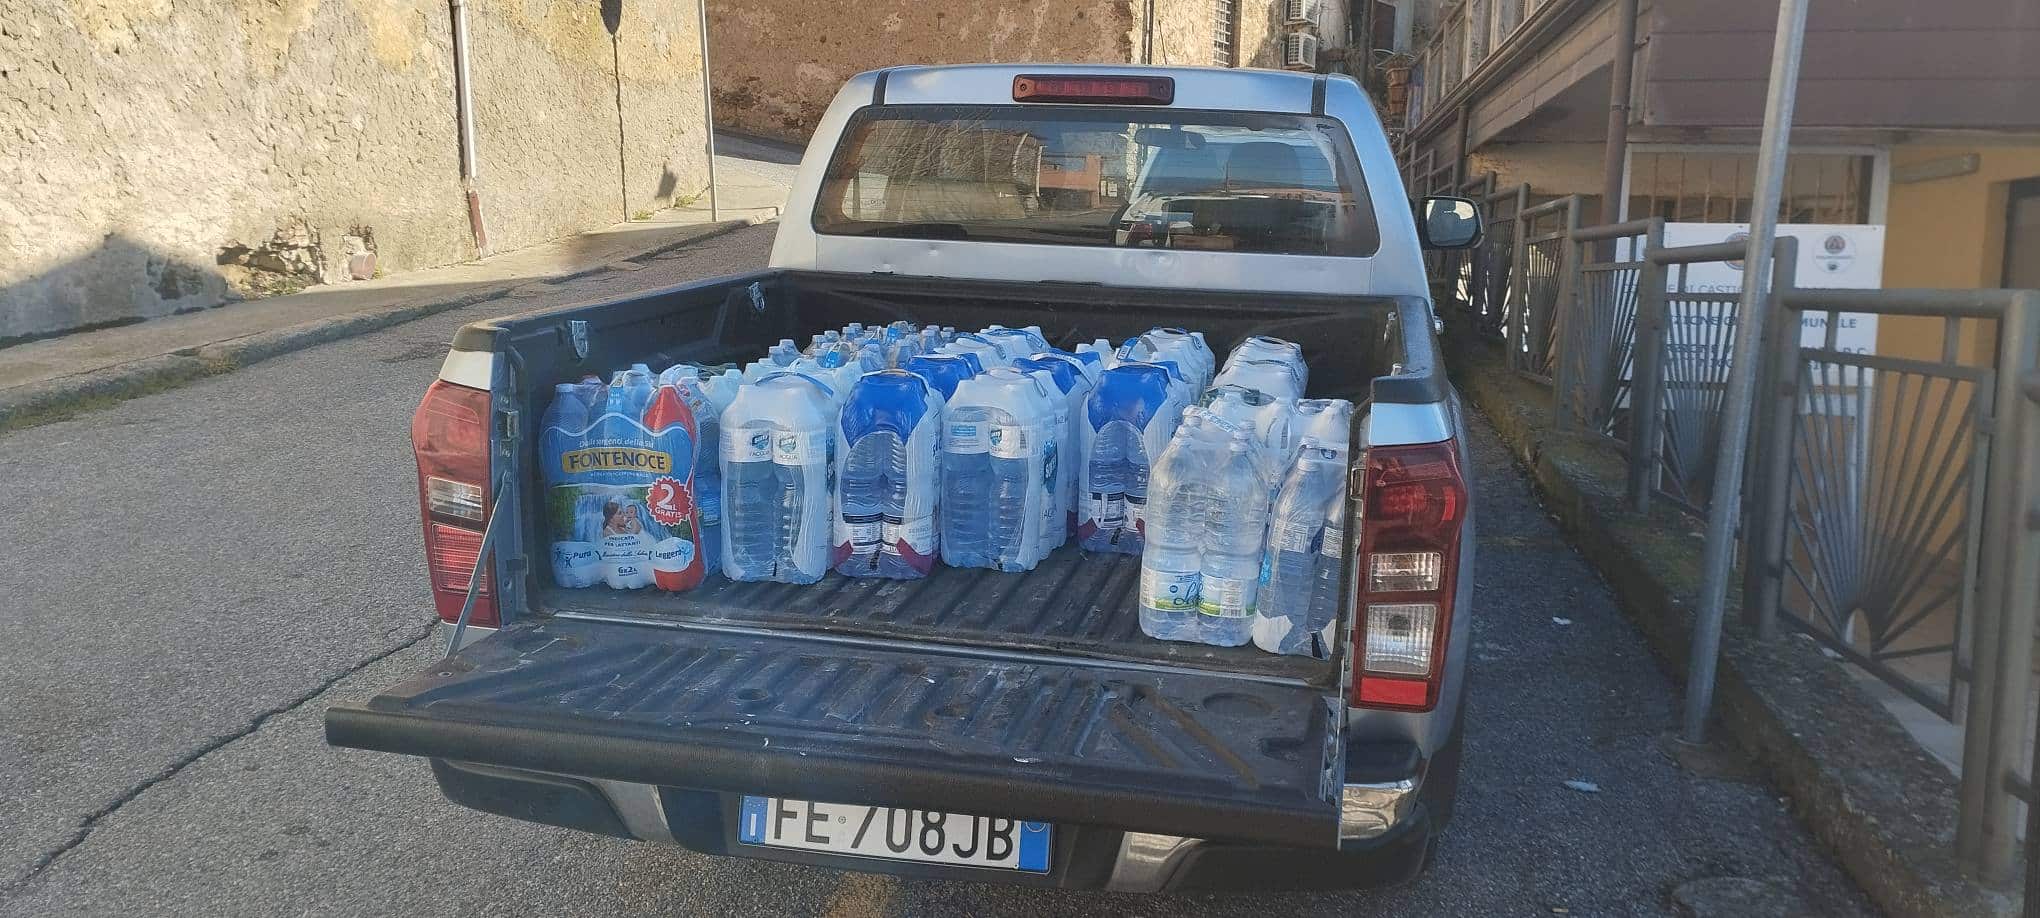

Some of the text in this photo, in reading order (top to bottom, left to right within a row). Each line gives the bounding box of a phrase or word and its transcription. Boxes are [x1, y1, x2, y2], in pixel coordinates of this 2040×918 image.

[568, 451, 666, 470] FONTENOCE
[655, 507, 682, 518] GRATIS
[573, 550, 592, 559] Pura
